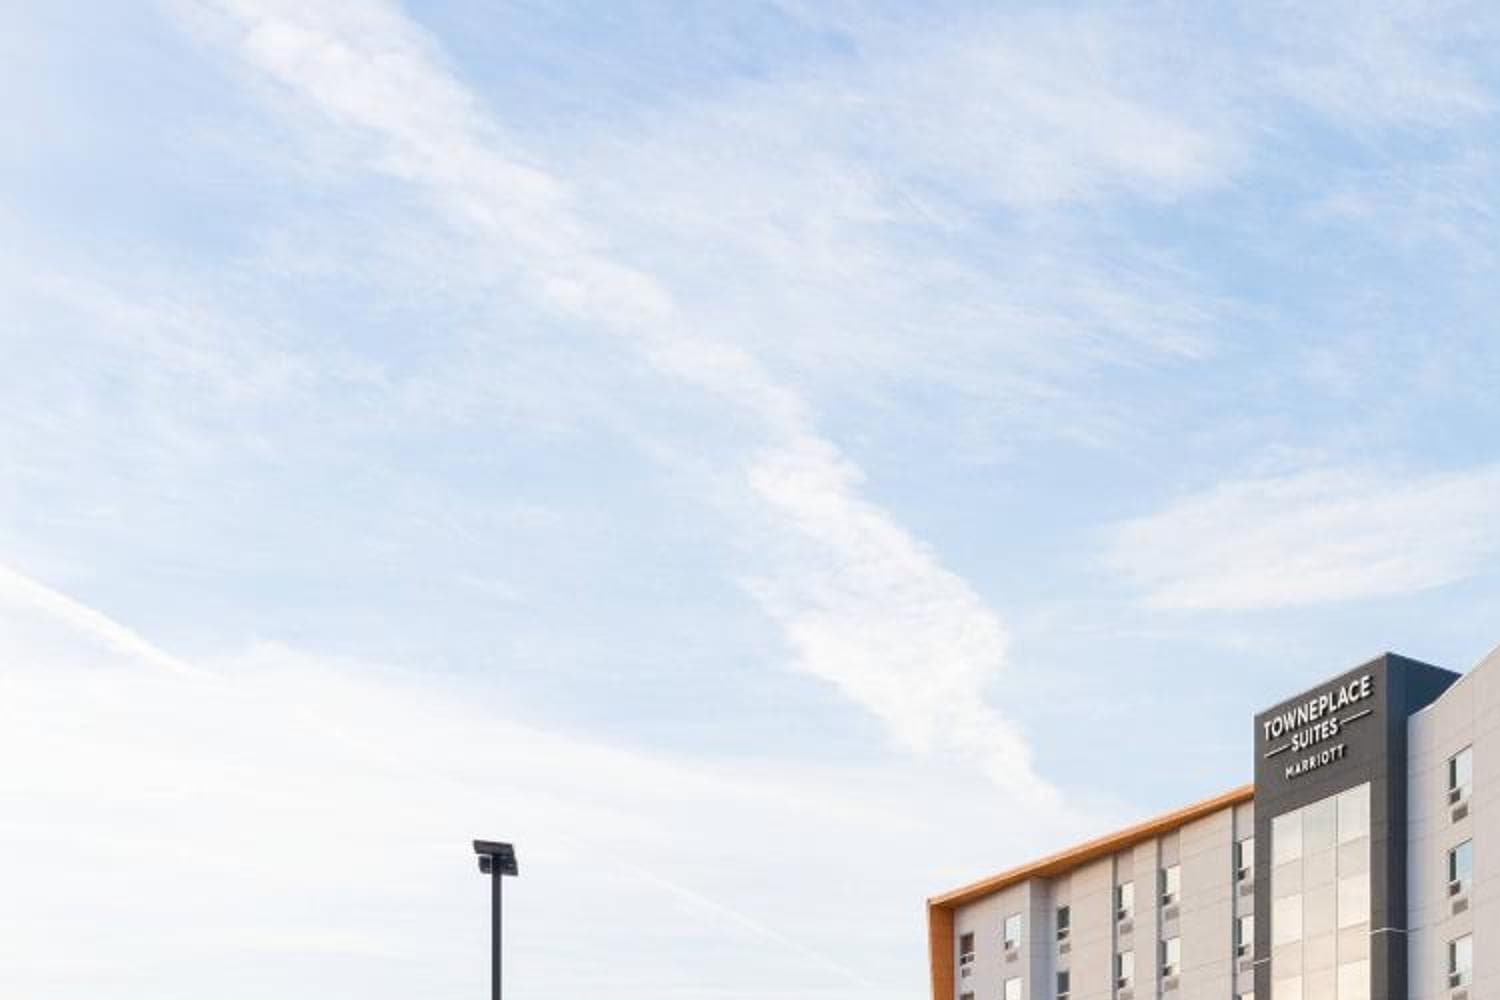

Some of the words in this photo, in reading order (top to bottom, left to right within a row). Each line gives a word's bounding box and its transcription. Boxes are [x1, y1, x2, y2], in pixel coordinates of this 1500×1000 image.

[1264, 675, 1371, 740] TOWNEPLACE
[1291, 718, 1338, 751] SUITES
[1286, 744, 1345, 779] MARRIOTT
